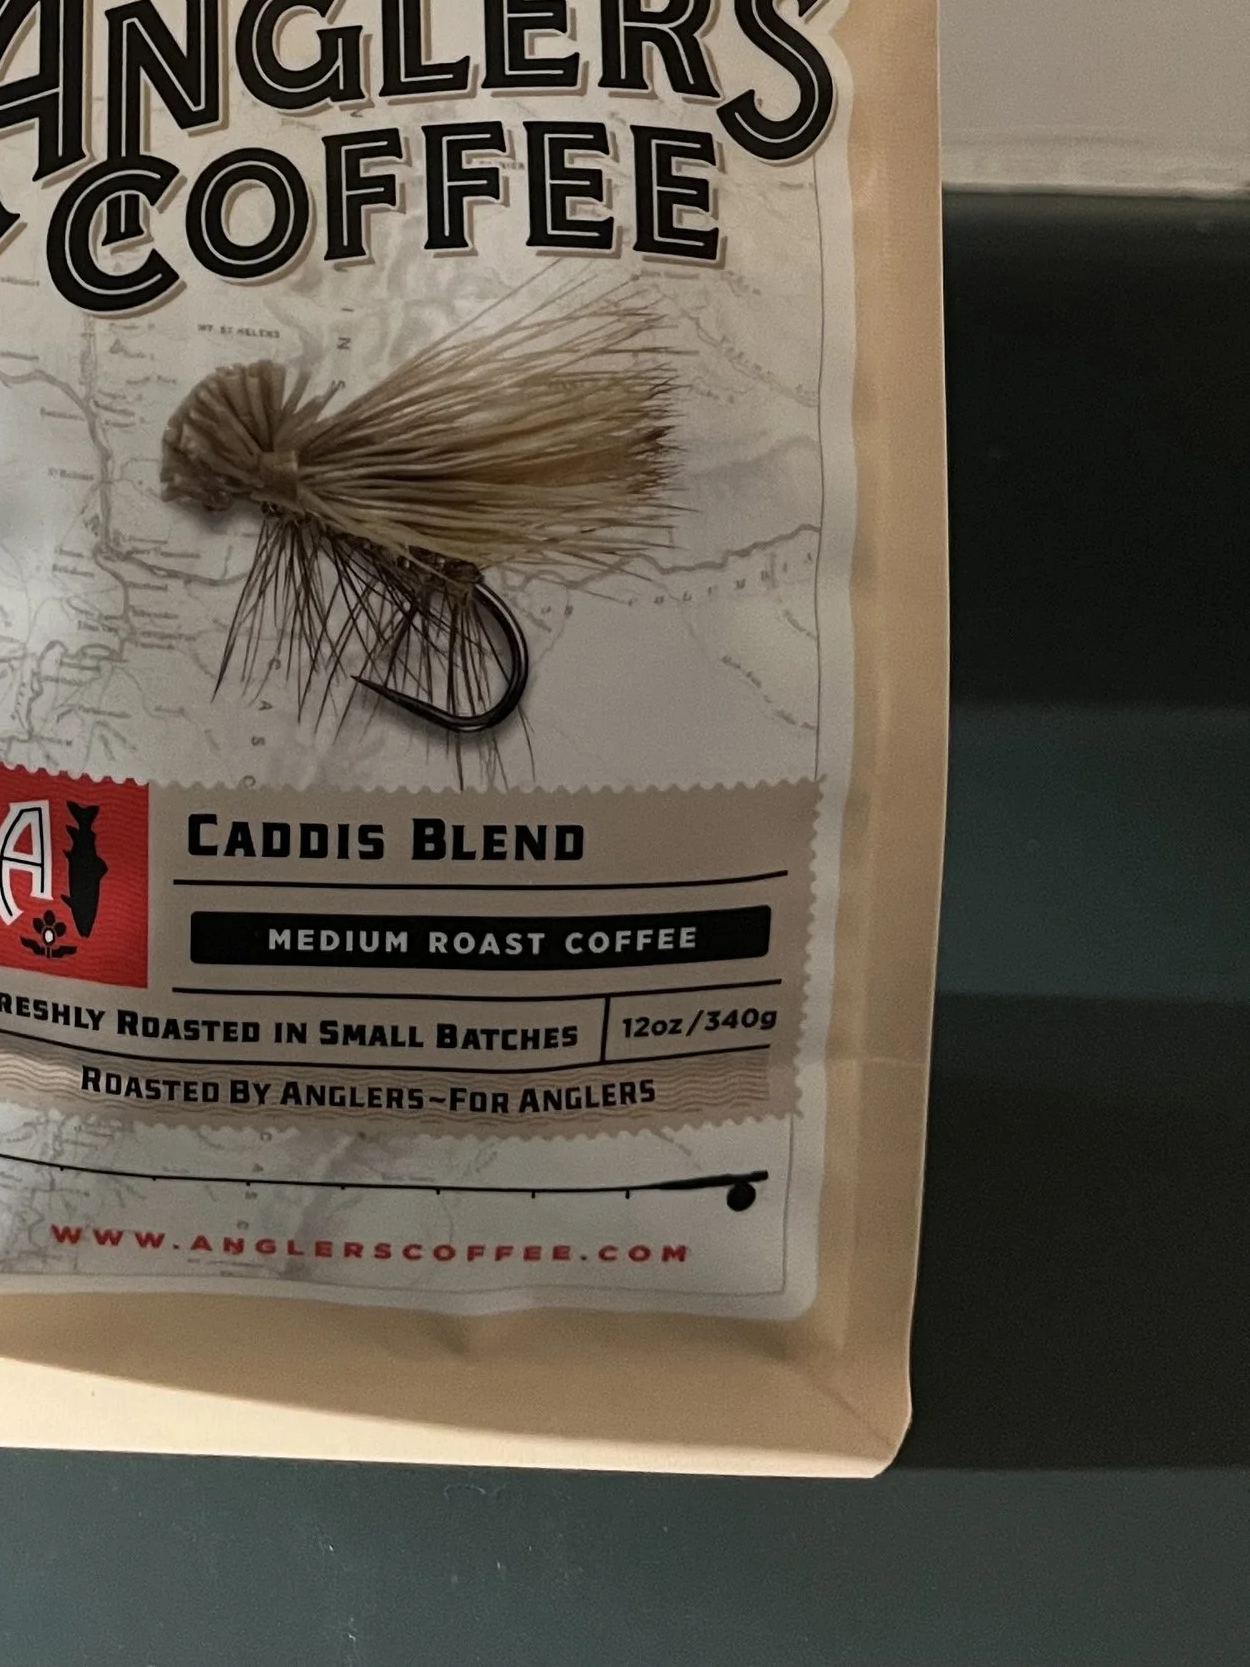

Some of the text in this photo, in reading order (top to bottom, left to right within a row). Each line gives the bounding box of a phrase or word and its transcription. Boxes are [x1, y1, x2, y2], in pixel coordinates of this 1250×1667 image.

[45, 120, 722, 313] COFFEE
[187, 813, 585, 861] CADDIS BLEND
[268, 926, 698, 956] MEDIUM ROAST COFFEE
[117, 1009, 261, 1043] ROASTED
[274, 1022, 308, 1045] IN
[319, 1019, 425, 1048] SMALL
[436, 1022, 579, 1051] BATCHES
[622, 1007, 778, 1039] 12oz/340g
[80, 1064, 220, 1104] ROASTED
[229, 1079, 272, 1106] BY
[518, 1078, 656, 1114] ANGLERS
[50, 1224, 688, 1264] WWW.ANGLERSCOFFEE.COM
